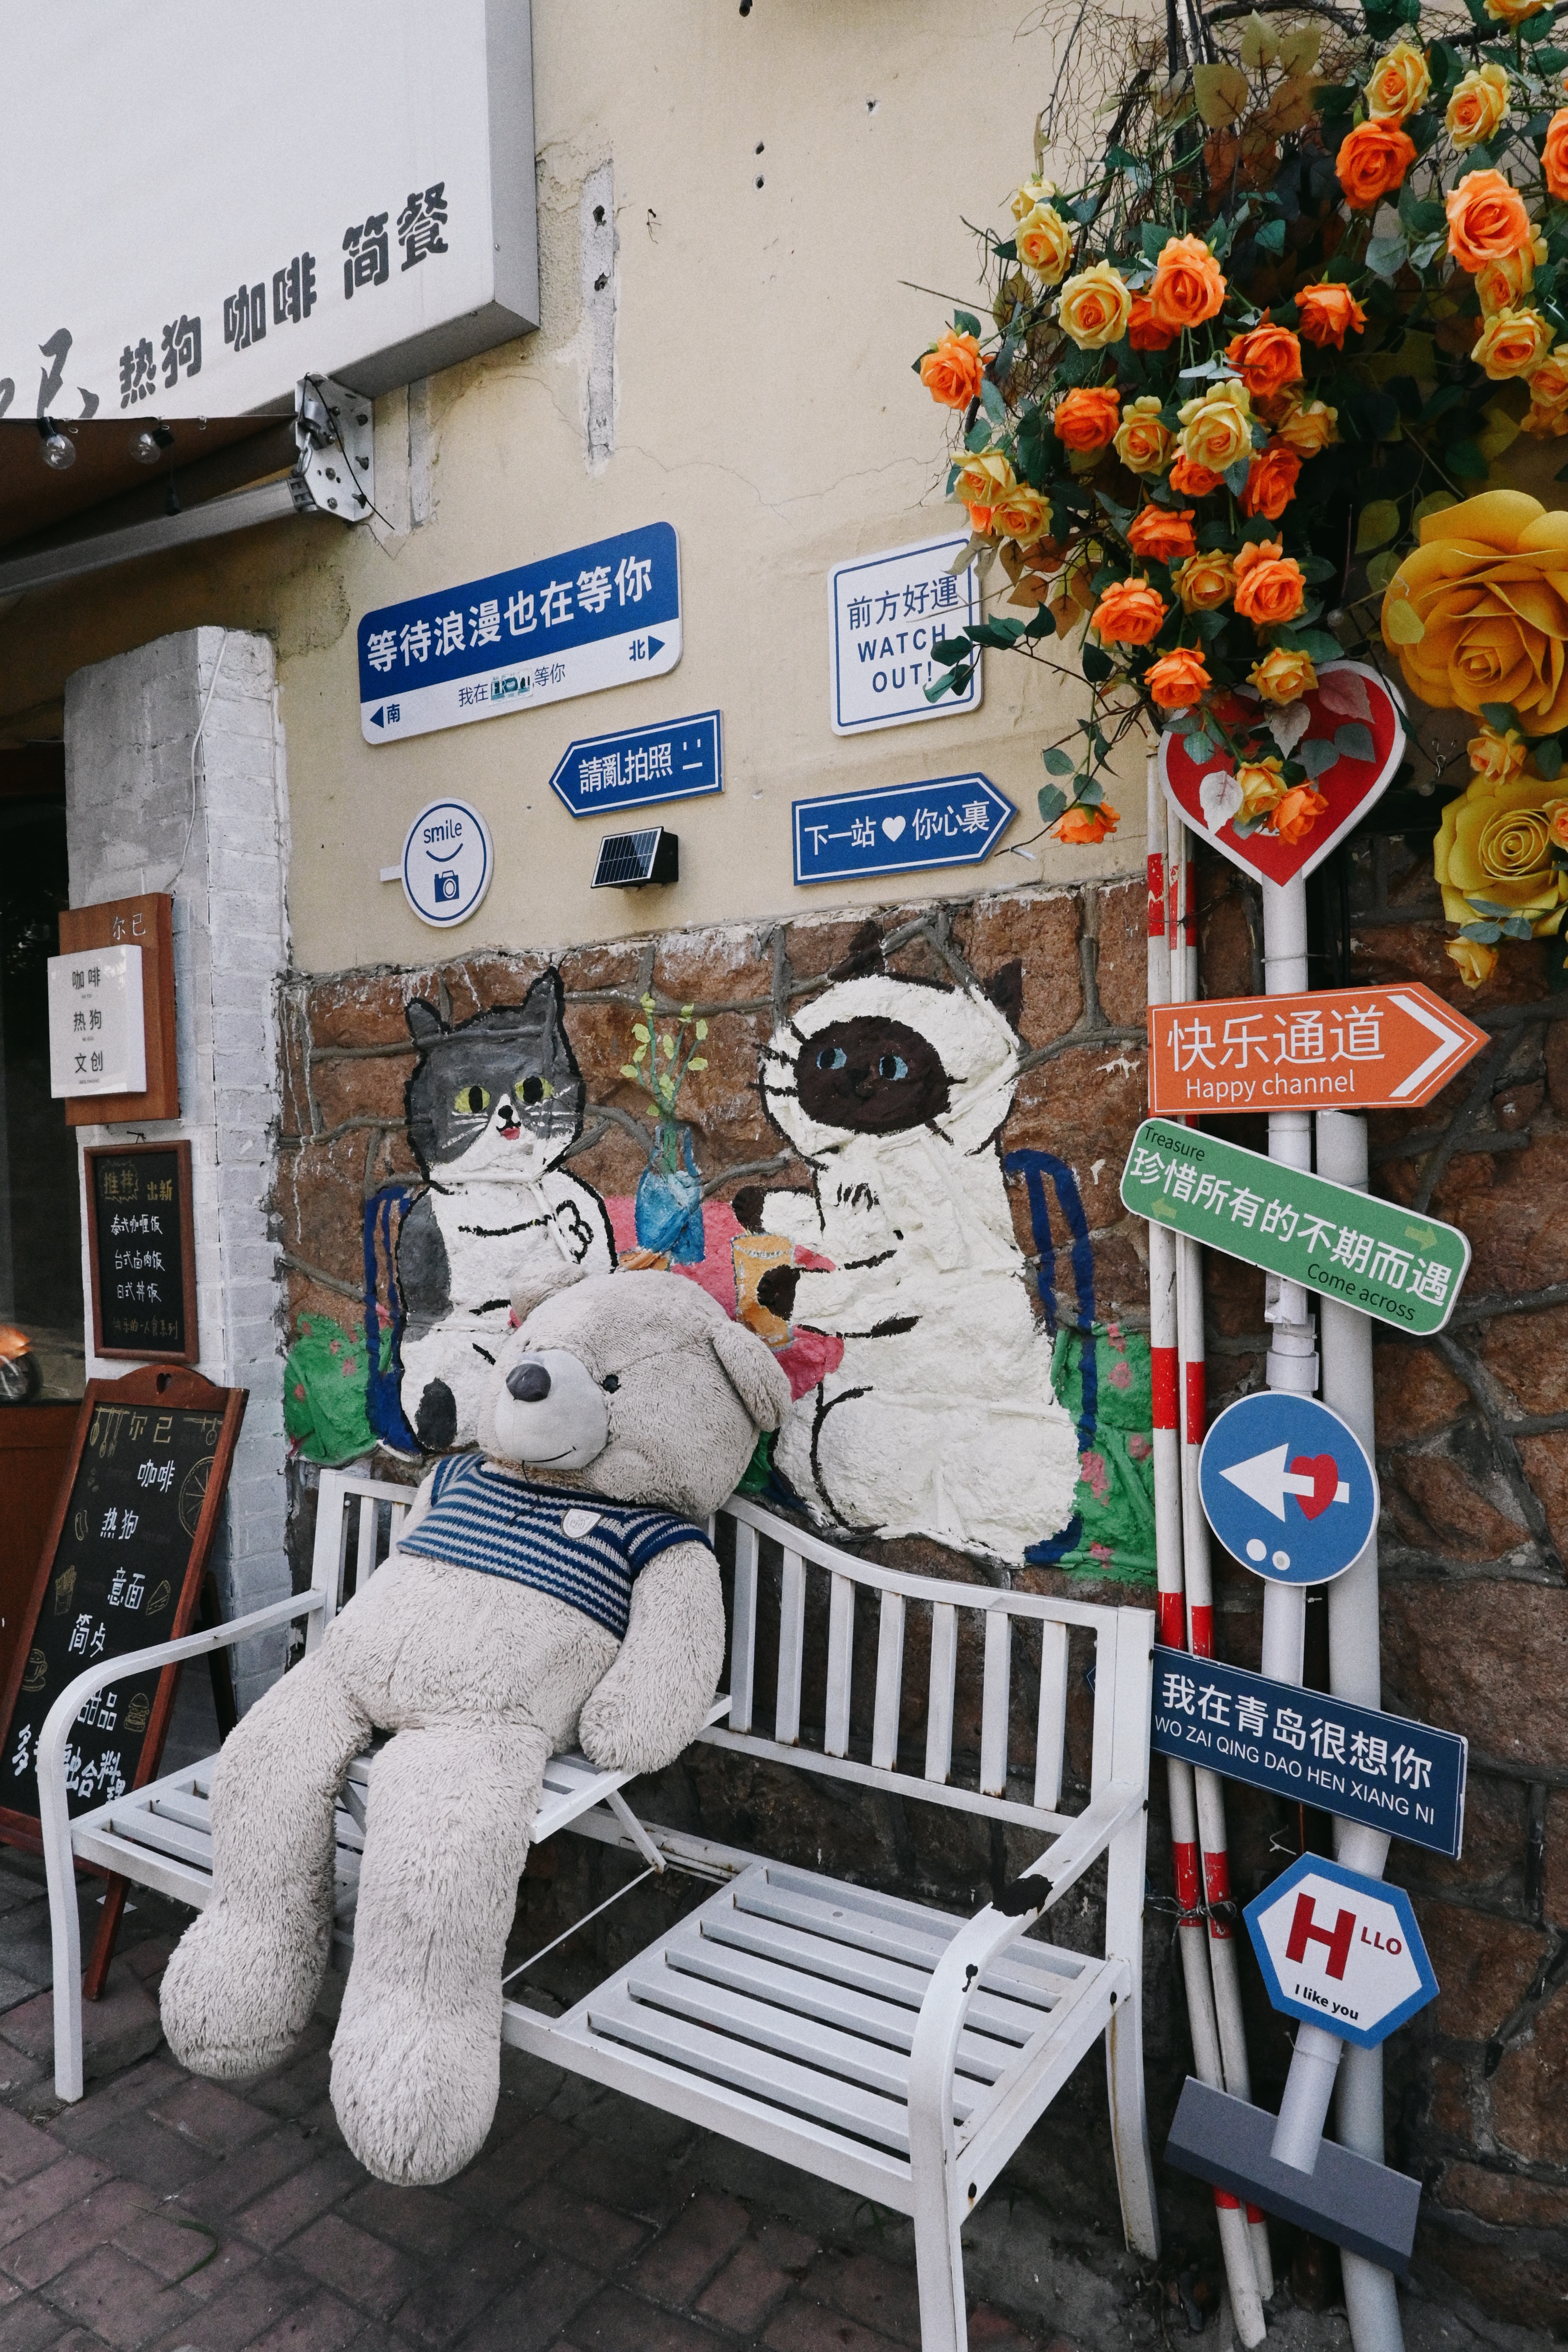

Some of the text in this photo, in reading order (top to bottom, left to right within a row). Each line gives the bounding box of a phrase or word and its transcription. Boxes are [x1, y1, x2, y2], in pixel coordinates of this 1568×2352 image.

[342, 181, 449, 300] 简餐
[224, 252, 317, 352] 咖啡
[119, 314, 201, 409] 热狗
[367, 555, 652, 672] 等待浪漫也在等你
[847, 574, 959, 630] 前方好運
[629, 640, 645, 662] 北
[858, 623, 946, 663] WATCH
[872, 661, 932, 693] OUT!
[387, 704, 400, 724] 南
[578, 743, 673, 794] 請亂拍照
[423, 819, 462, 845] smile
[804, 816, 877, 856] 下一站
[72, 966, 101, 990] 咖啡
[74, 1009, 102, 1032] 热狗
[1167, 1004, 1385, 1072] 快乐通道
[75, 1051, 103, 1074] 文创
[1186, 1070, 1355, 1103] Happy channel
[1143, 1126, 1206, 1162] Treasure
[1130, 1147, 1452, 1307] 珍惜所有的不期而遇
[115, 1249, 165, 1271] 台式卤肉饭
[1307, 1263, 1416, 1321] Come across
[137, 1459, 175, 1492] 咖啡
[100, 1507, 139, 1539] 热狗
[108, 1567, 145, 1609] 意面
[1162, 1673, 1432, 1790] 我在青岛很想你
[1155, 1715, 1434, 1825] WO ZAI QING DAO HEN XIANG NI
[1295, 1984, 1359, 2020] I like you
